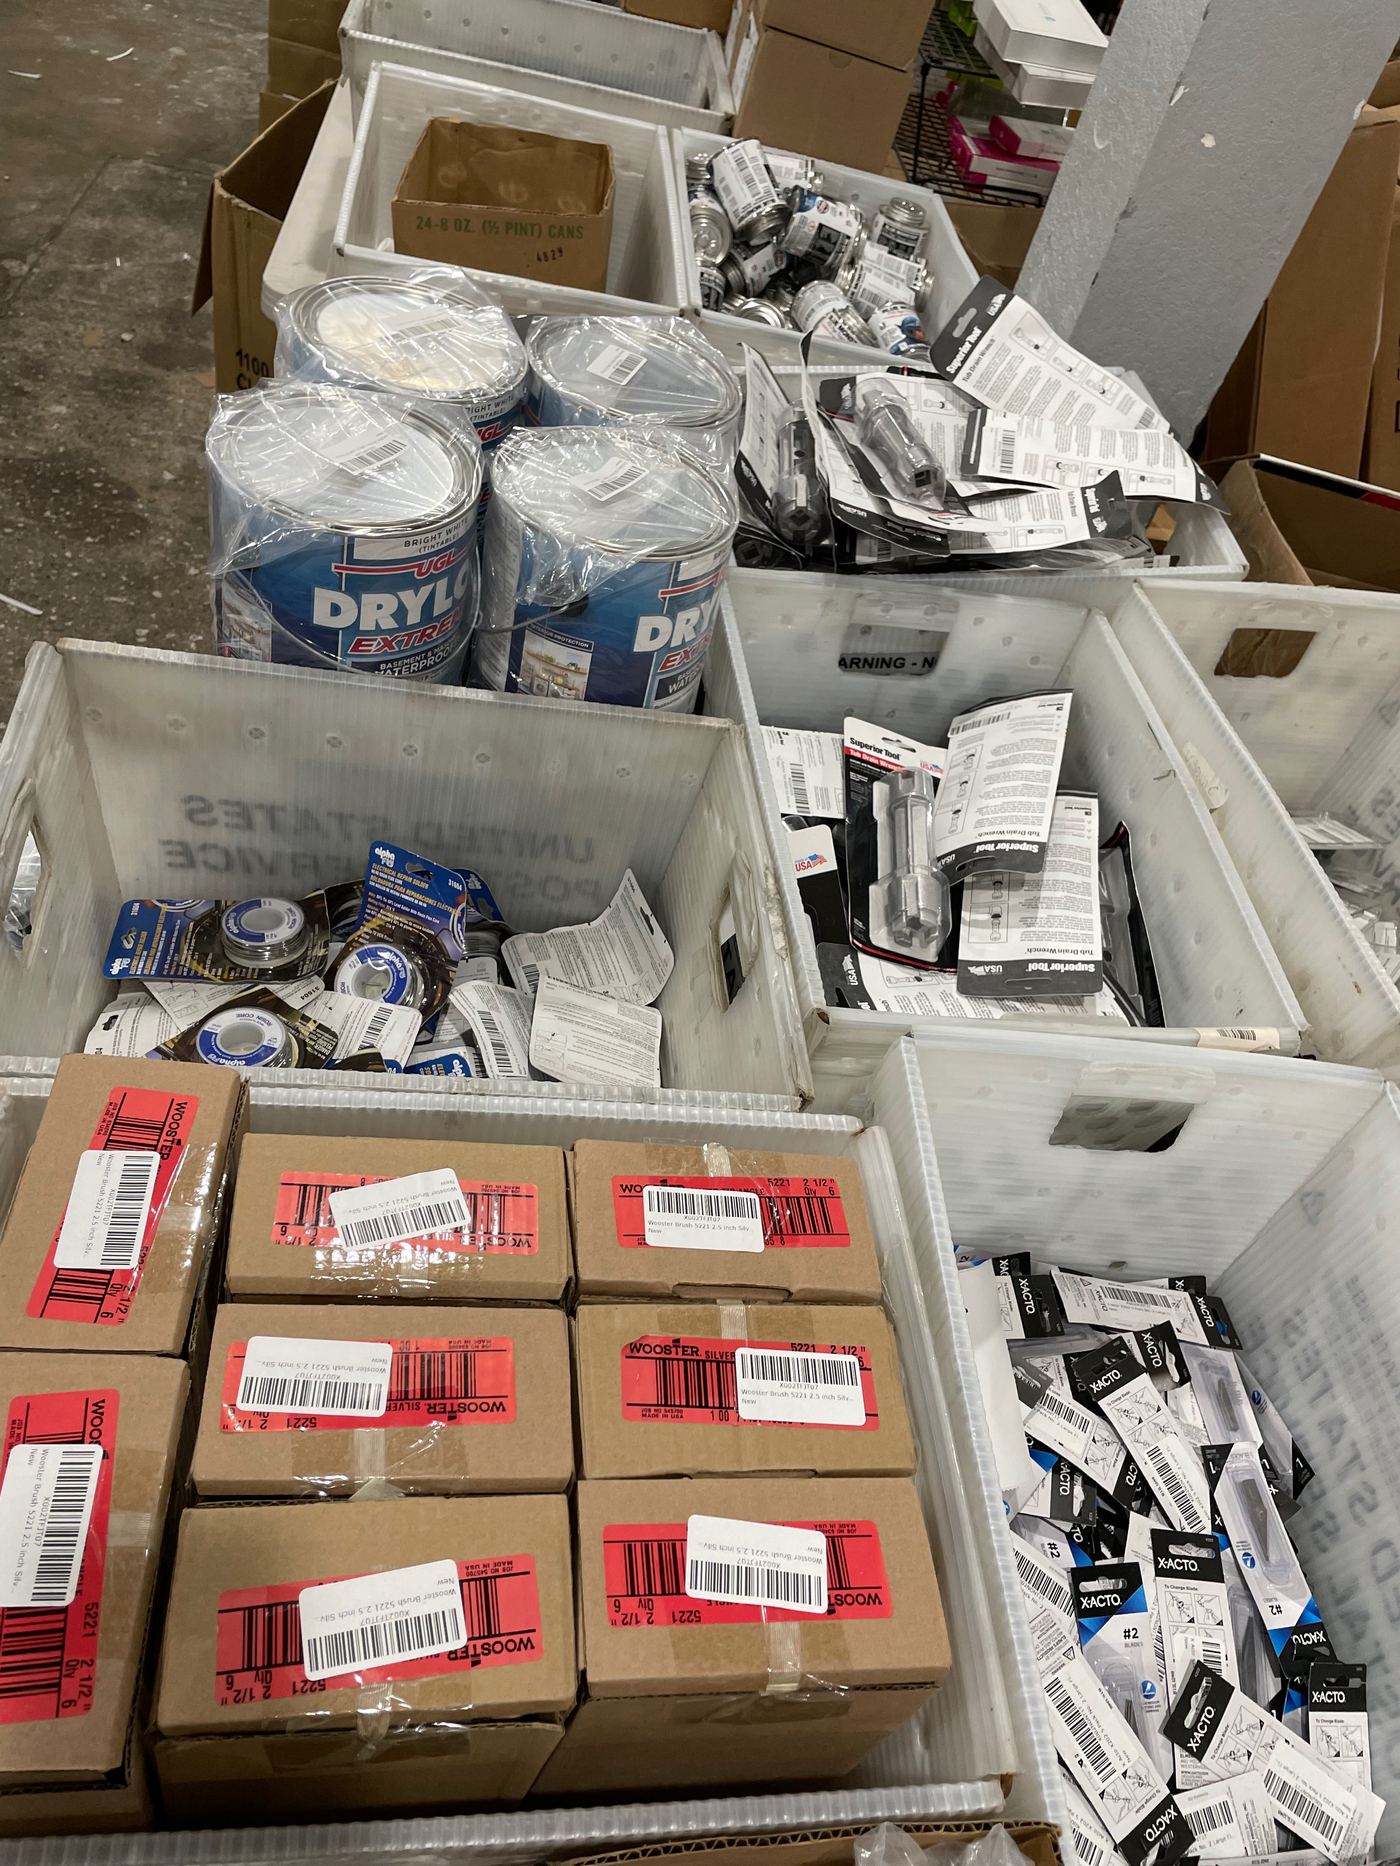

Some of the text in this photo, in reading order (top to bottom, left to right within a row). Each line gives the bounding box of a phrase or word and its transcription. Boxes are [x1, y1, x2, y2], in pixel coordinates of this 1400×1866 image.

[416, 216, 448, 231] 24-8
[454, 218, 475, 233] OZ.
[505, 222, 542, 237] PINT)
[548, 225, 584, 239] CANS
[946, 326, 983, 375] Superior Tool
[235, 349, 269, 377] 1100
[404, 517, 468, 547] BRIGHT WHITE
[418, 533, 459, 553] (TINTABLE)
[415, 550, 458, 579] UGL
[313, 559, 468, 631] DRYLO
[554, 634, 589, 649] PROTECTION
[380, 650, 433, 670] BASEMENT &
[838, 657, 906, 669] ARNING
[922, 657, 935, 668] N
[850, 737, 883, 754] Superior
[884, 749, 900, 760] Tool
[850, 749, 861, 758] Tub
[862, 752, 880, 765] Drain
[976, 830, 1006, 838] Wrench
[375, 847, 396, 862] alpha
[975, 841, 1039, 853] Superior Tool
[794, 859, 814, 872] USA
[397, 872, 413, 883] REPAIR
[412, 878, 429, 890] SOLDER
[1026, 947, 1056, 955] Wrench
[1080, 948, 1094, 956] Tub
[985, 962, 1095, 972] Superior Tool USA
[847, 967, 858, 986] USA
[257, 1015, 272, 1027] ROSIN
[94, 1154, 115, 1214] Wooster Brush 5221
[768, 1178, 827, 1187] 5221 2 1/2
[804, 1187, 834, 1197] Qty 6
[116, 1101, 188, 1314] WOOSTER 1/2
[280, 1226, 287, 1237] 6
[648, 1220, 710, 1230] Wooster 5221
[107, 1283, 122, 1297] Qty
[1019, 1278, 1036, 1314] X-ACTO
[1195, 1296, 1215, 1328] X-ACTO
[629, 1342, 858, 1357] WOOSTER 5221 2 1/2
[1142, 1332, 1162, 1368] X-ACTO
[1089, 1369, 1122, 1394] X-ACTO
[741, 1389, 768, 1397] Wooster
[260, 1401, 506, 1430] WOOSTER 5221 2
[718, 1411, 729, 1421] 00
[26, 1448, 38, 1466] New
[1060, 1459, 1070, 1496] X-ACTO
[15, 1448, 49, 1568] Wooster Brush 5221 inch
[34, 1496, 51, 1547] X002TFJT07
[750, 1548, 823, 1565] Wooster 5221
[807, 1545, 823, 1554] New
[1047, 1542, 1060, 1558] #2
[464, 1560, 513, 1572] MADE USA
[1157, 1558, 1199, 1572] X-ACTO
[437, 1577, 455, 1587] New
[338, 1588, 456, 1620] Wooster Brush 5221 inch
[614, 1597, 654, 1613] Qty 6
[1080, 1594, 1122, 1609] X-ACTO
[1268, 1604, 1283, 1615] #2
[620, 1610, 702, 1625] 5221 2 1/2
[1123, 1628, 1139, 1639] #2
[1291, 1630, 1326, 1645] X-ACTO
[78, 1602, 99, 1699] 5221 2 1/2
[233, 1637, 535, 1704] WOOSTER 5221 2 1/2
[61, 1659, 79, 1708] Qty 6
[226, 1669, 273, 1691] Qty 6
[1312, 1691, 1346, 1703] X-ACTO
[1187, 1706, 1217, 1752] X-ACTO
[1215, 1737, 1224, 1754] Change
[1145, 1805, 1178, 1841] X-ACTO
